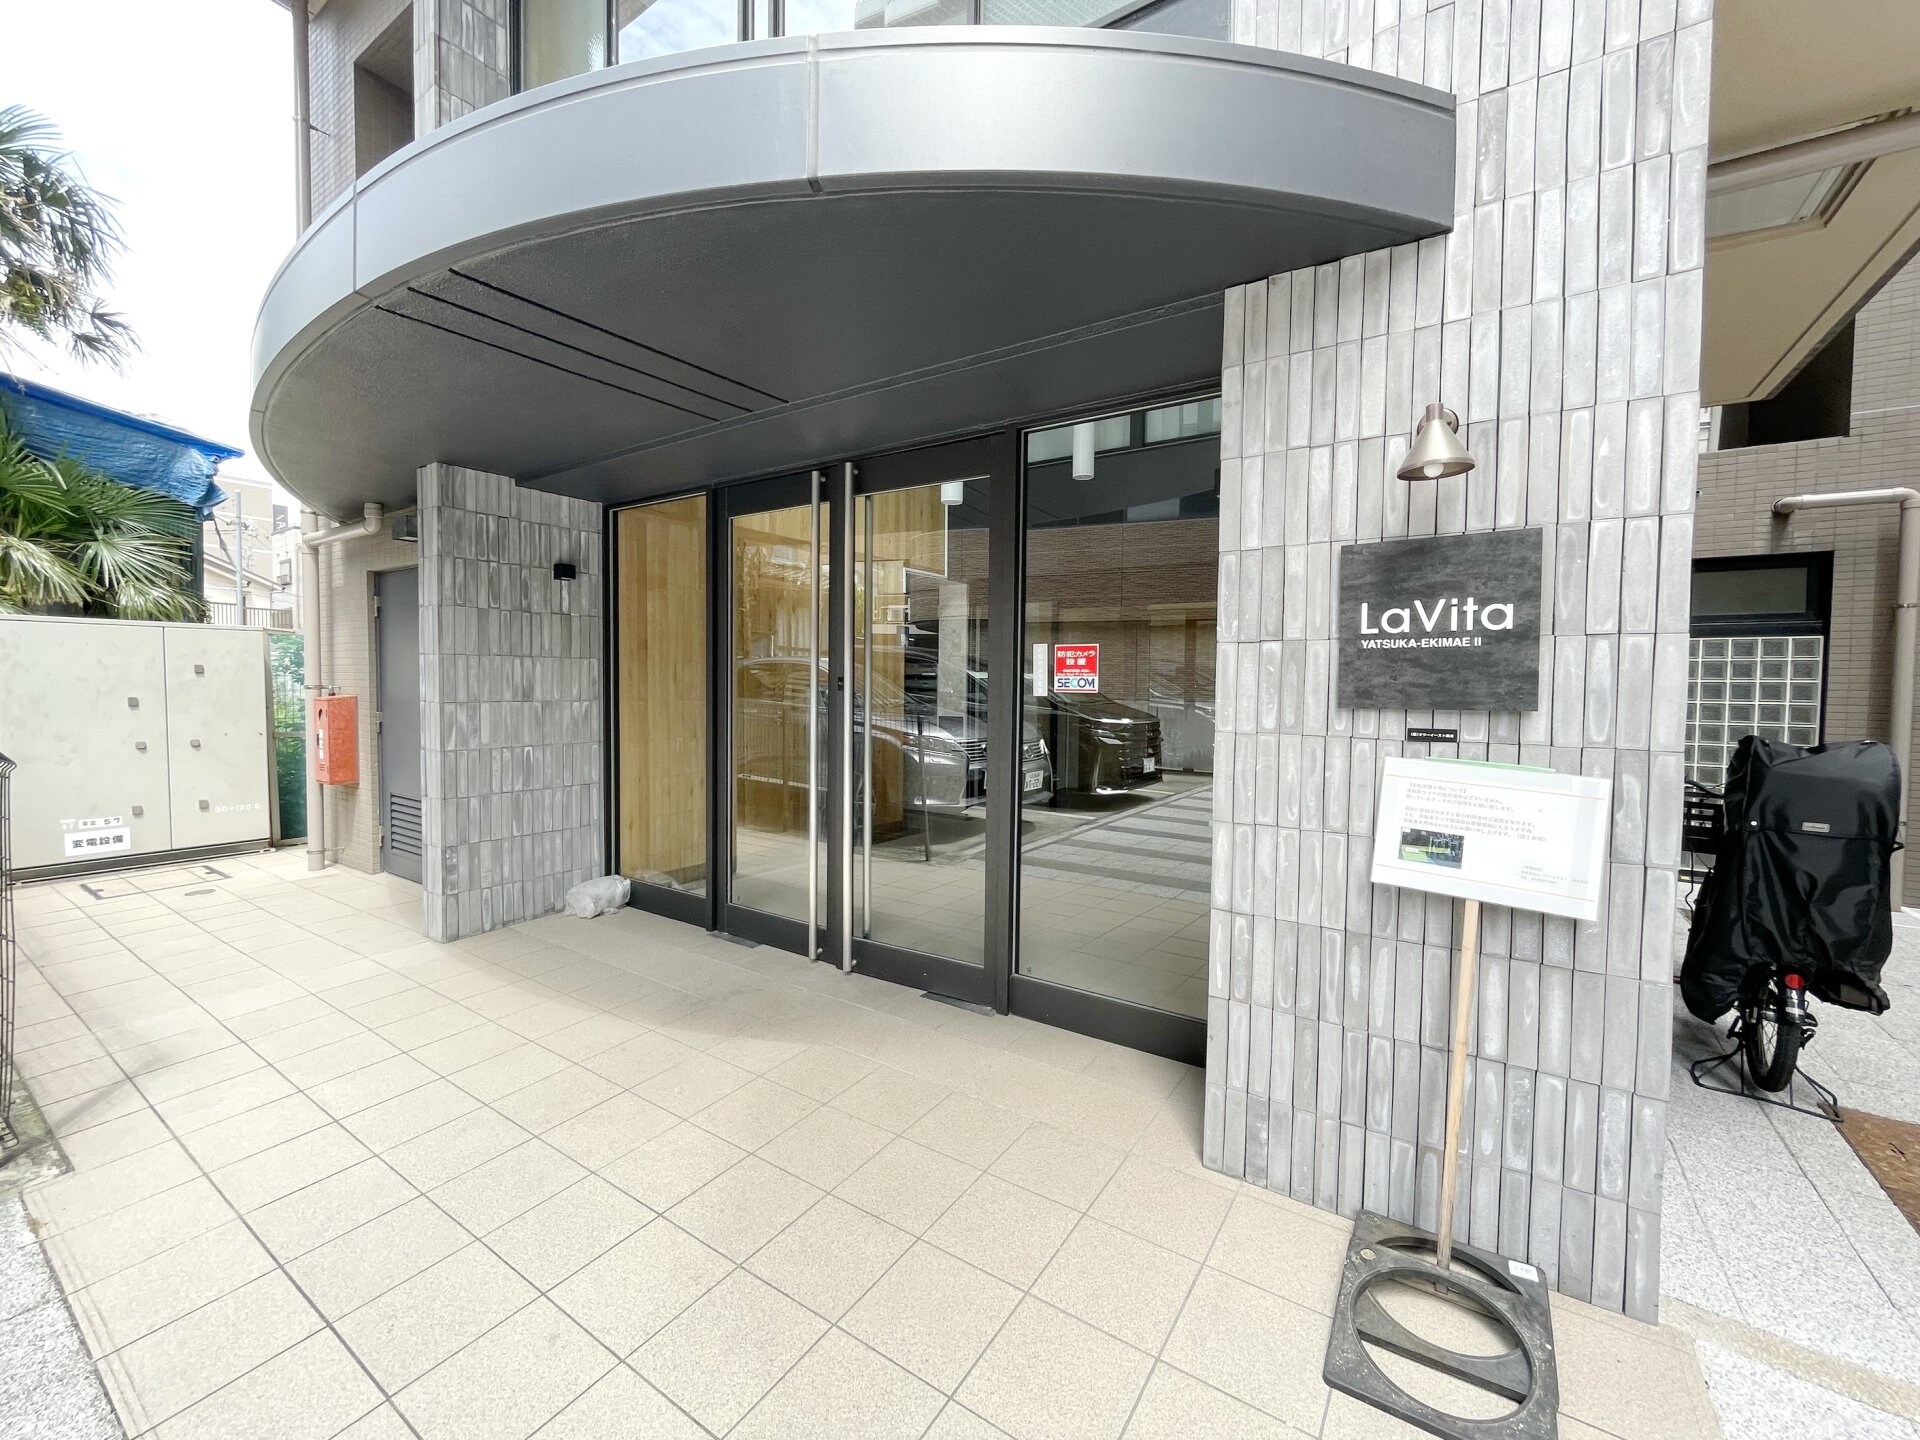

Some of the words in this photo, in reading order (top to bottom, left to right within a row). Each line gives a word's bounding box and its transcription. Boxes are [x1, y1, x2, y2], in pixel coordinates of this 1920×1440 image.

[1360, 597, 1514, 634] LaVita
[1361, 637, 1471, 649] YATSUKA-EKIMAE
[1057, 650, 1096, 658] 防犯カメラ
[1057, 677, 1095, 688] SECOM
[72, 834, 124, 849] 変電設備
